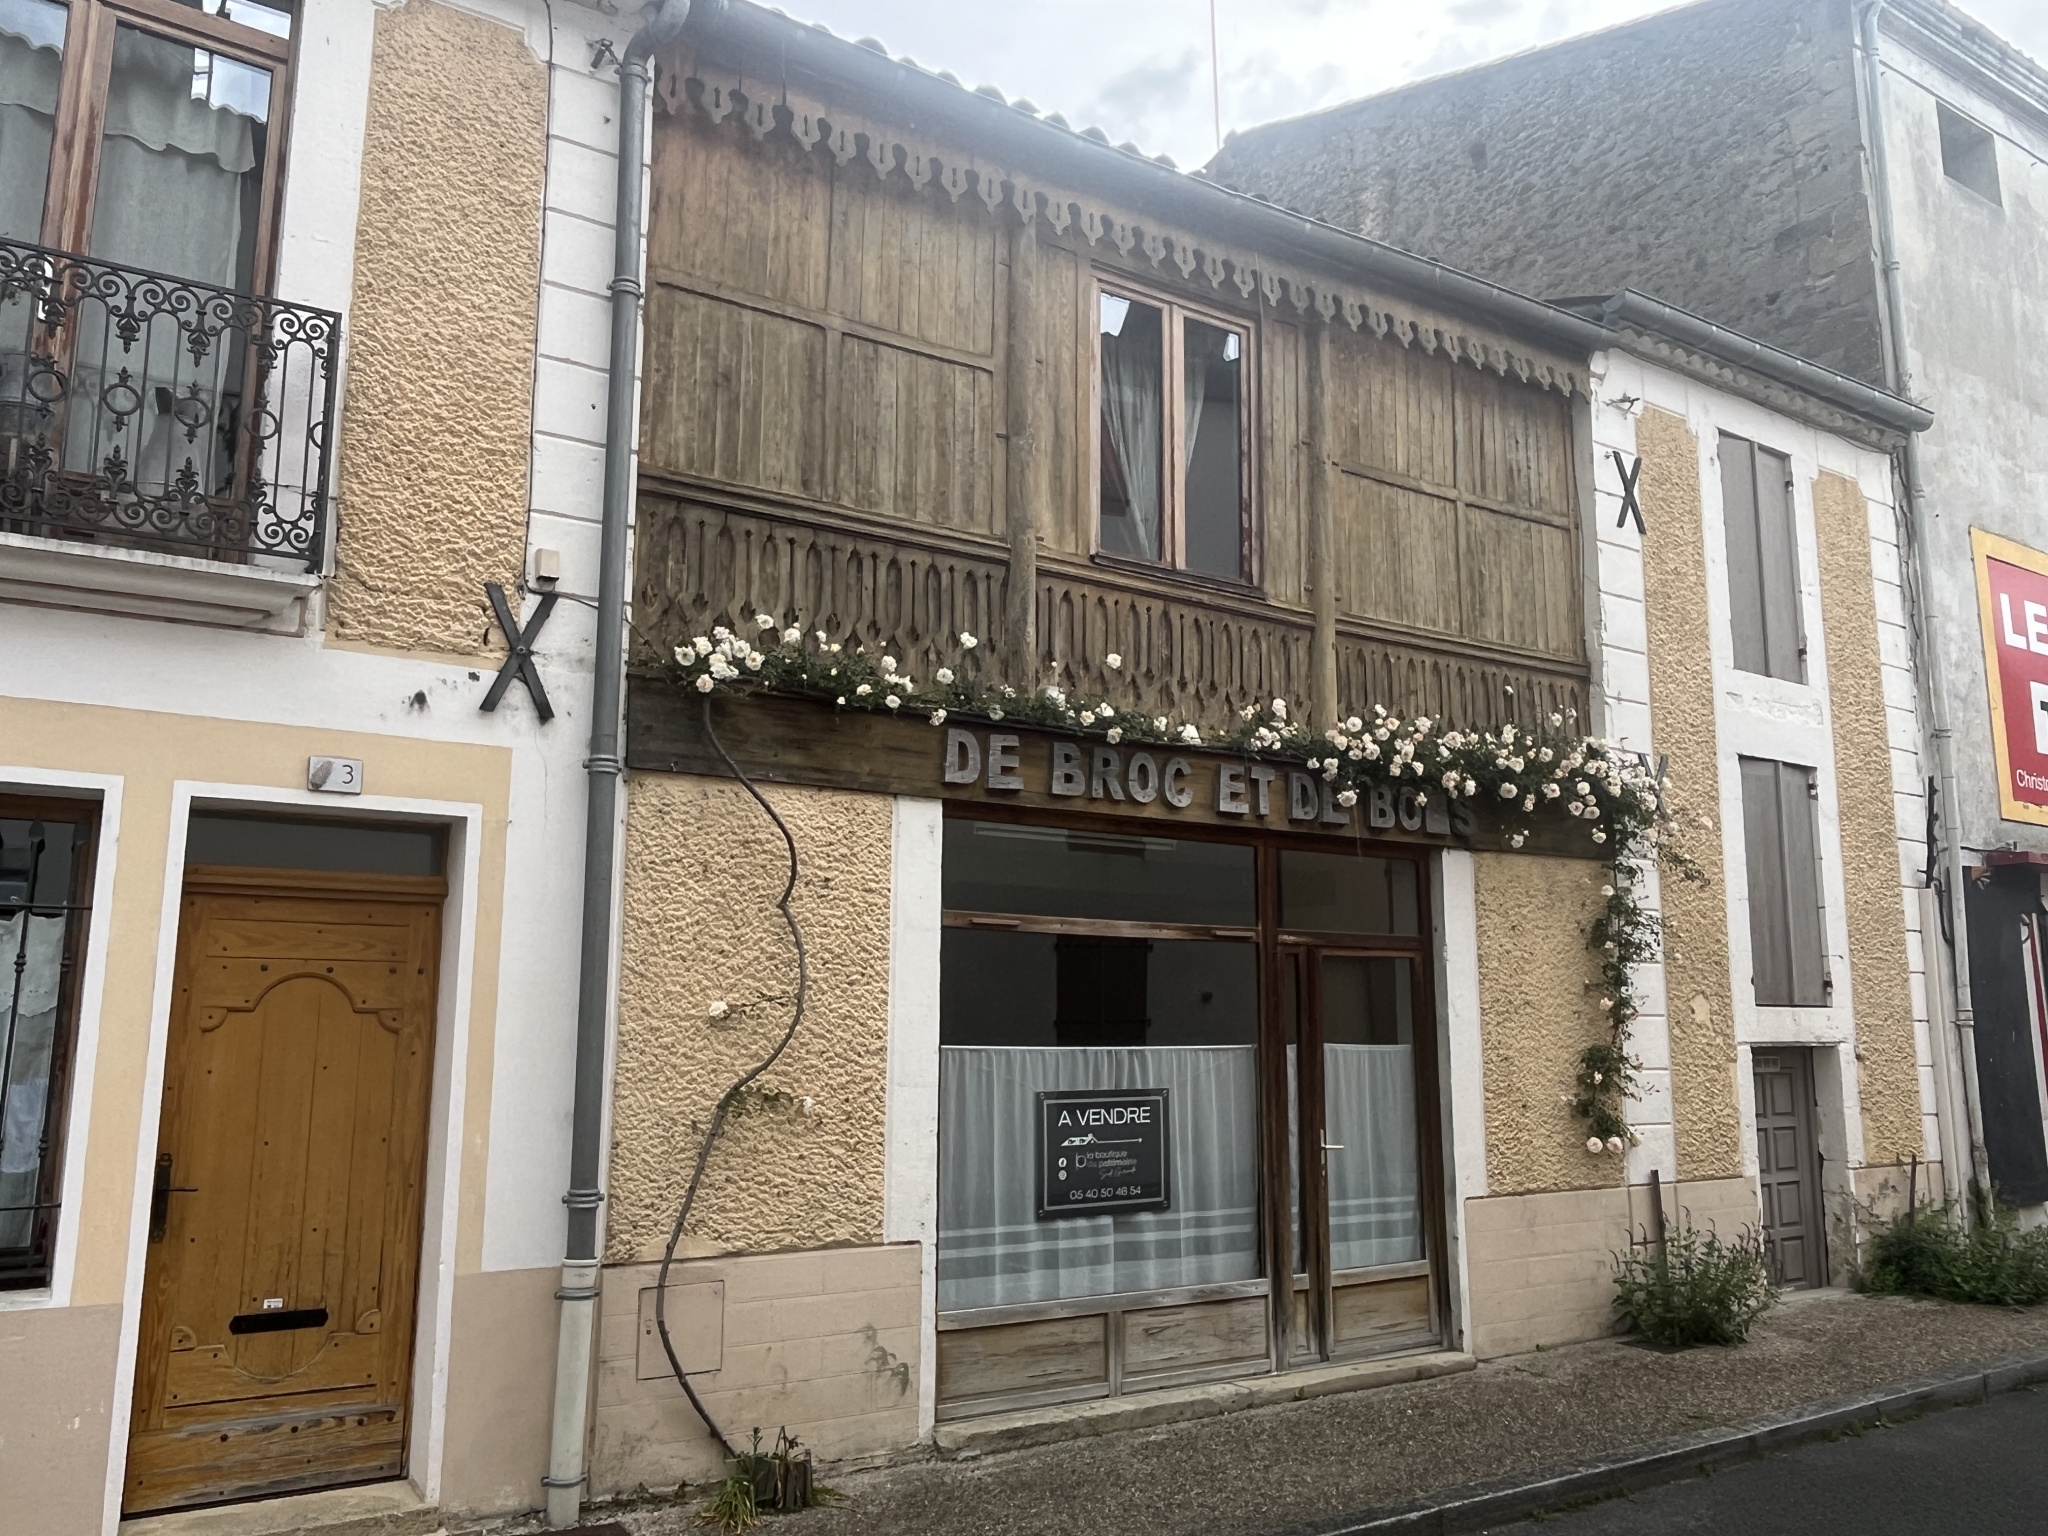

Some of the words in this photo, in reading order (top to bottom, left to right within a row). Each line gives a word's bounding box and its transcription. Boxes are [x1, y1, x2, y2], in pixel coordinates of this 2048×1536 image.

[342, 764, 354, 785] 3
[944, 728, 1024, 790] DE
[1051, 742, 1193, 808] BROC
[1219, 763, 1275, 816] ET
[1290, 772, 1350, 824] DE
[2016, 769, 2048, 792] Christ
[1058, 1110, 1072, 1127] A
[1076, 1107, 1151, 1126] VENDRE
[1095, 1150, 1128, 1159] boutique
[1069, 1190, 1084, 1200] 05
[1085, 1188, 1099, 1198] 40
[1100, 1187, 1114, 1198] 50
[1129, 1185, 1141, 1196] 54
